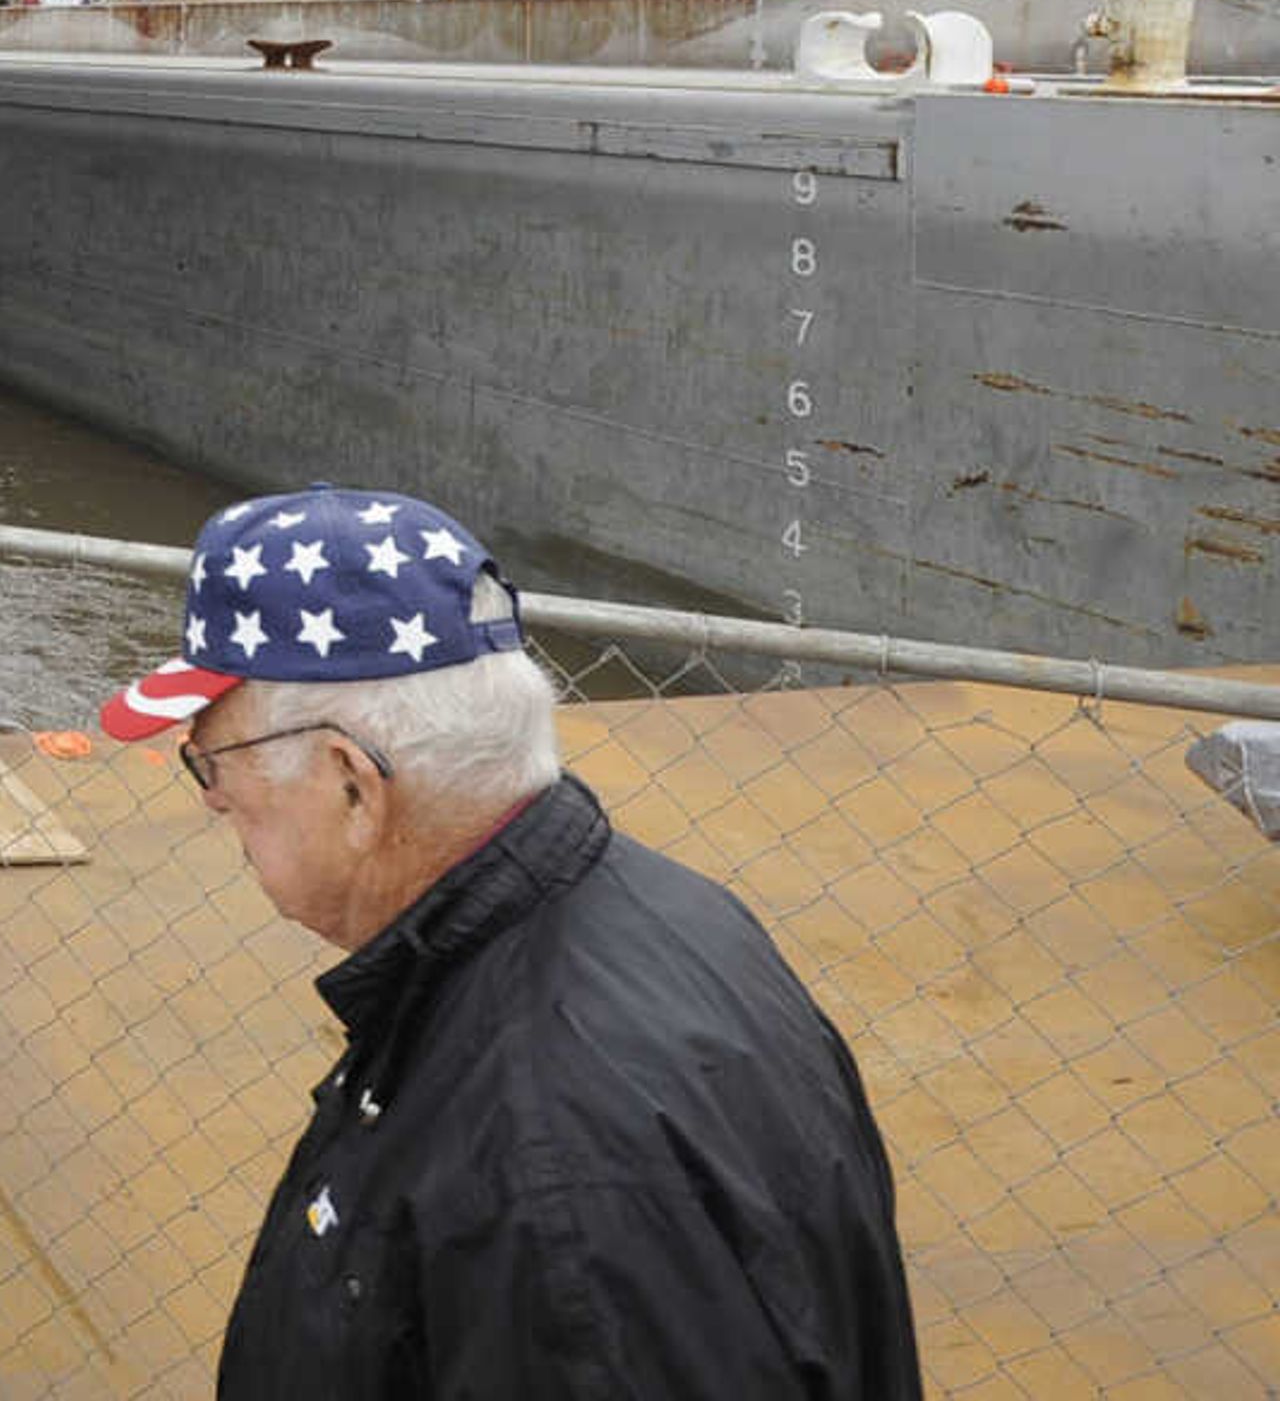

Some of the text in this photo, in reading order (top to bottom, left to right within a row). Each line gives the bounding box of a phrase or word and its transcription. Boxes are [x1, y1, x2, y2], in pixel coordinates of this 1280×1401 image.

[793, 171, 817, 205] 9
[791, 238, 817, 276] 8
[792, 309, 814, 344] 7
[788, 381, 812, 417] 6
[785, 450, 810, 487] 5
[782, 519, 808, 558] 4
